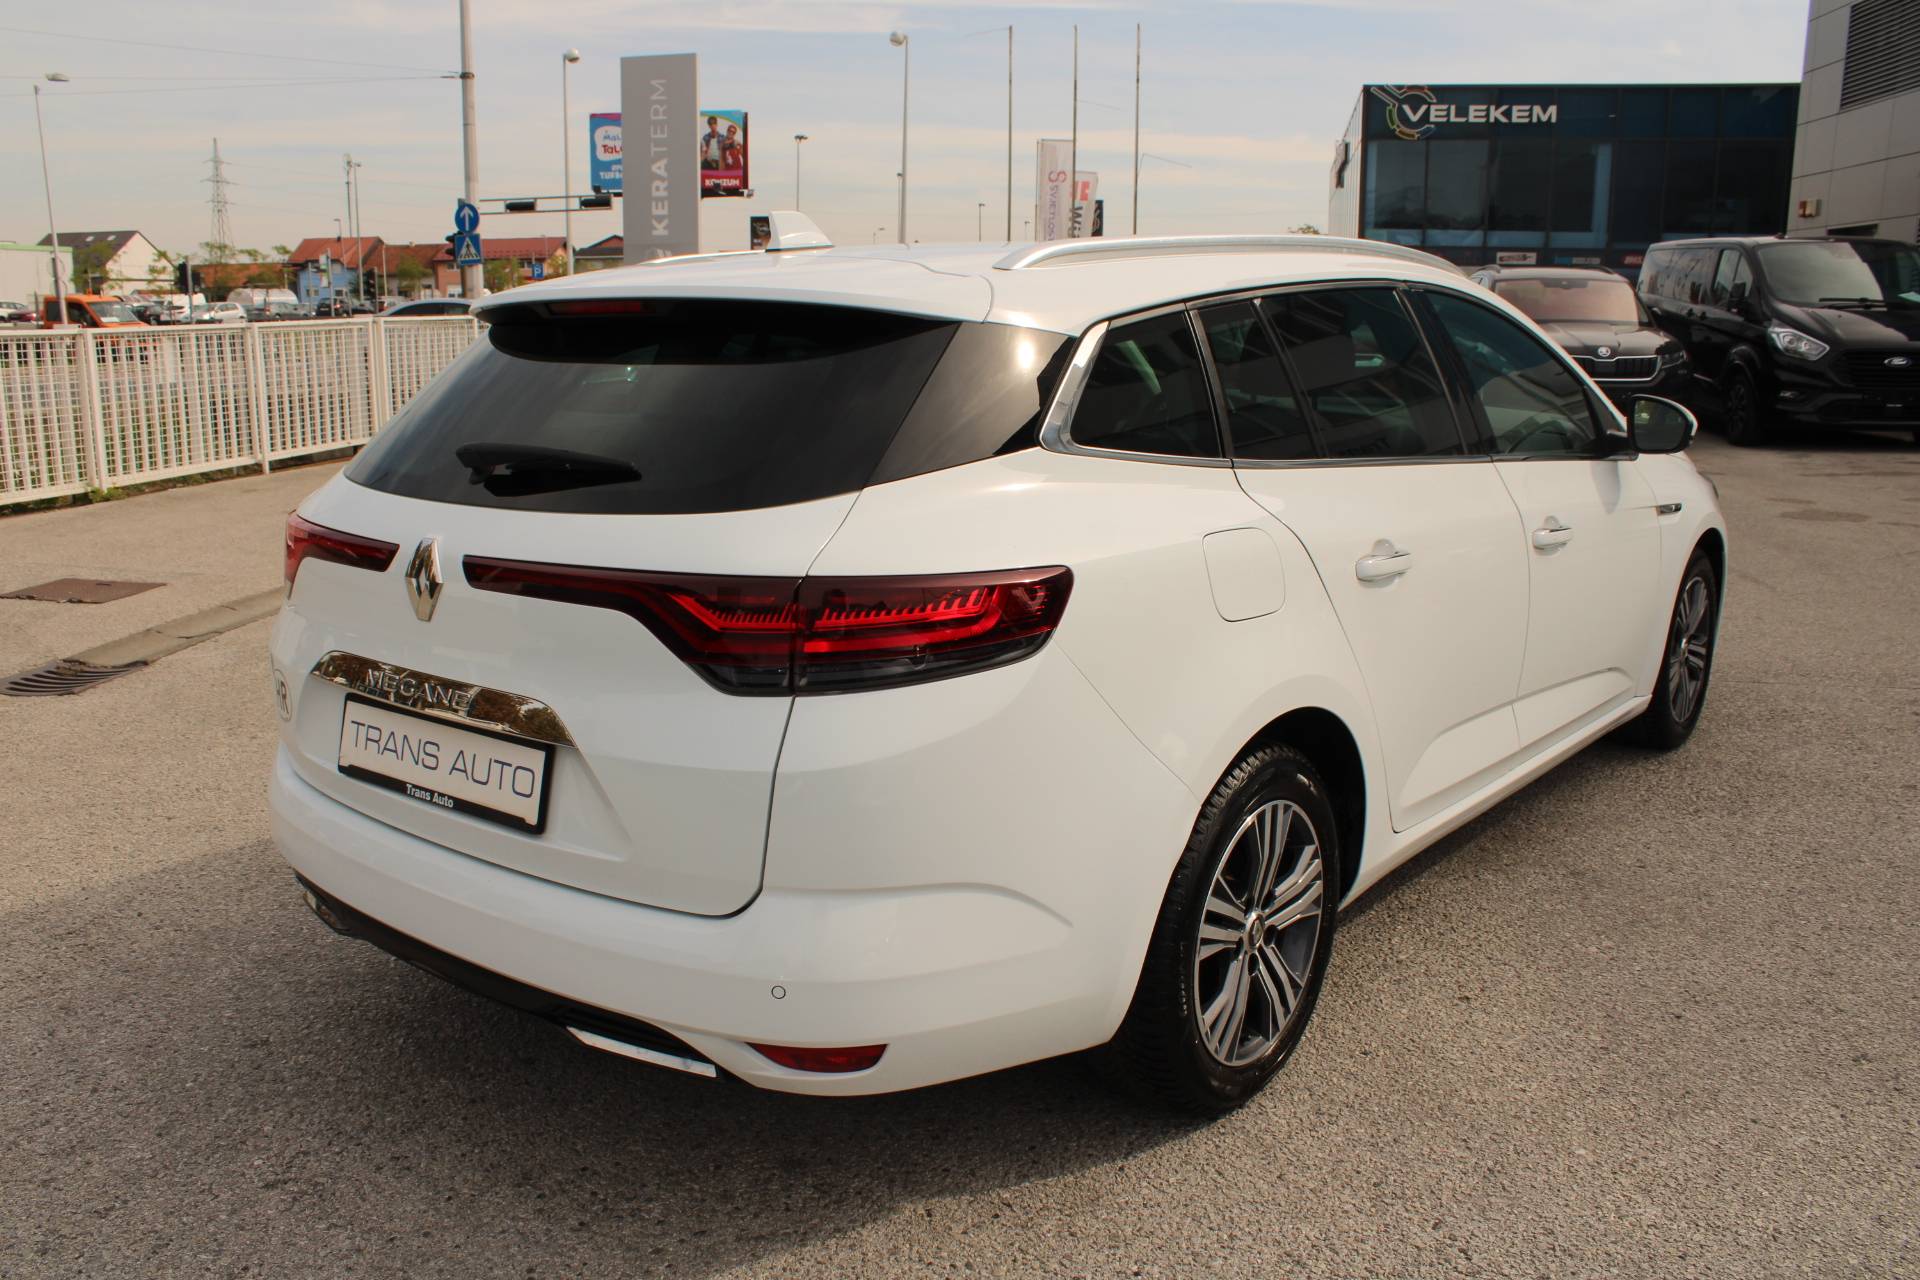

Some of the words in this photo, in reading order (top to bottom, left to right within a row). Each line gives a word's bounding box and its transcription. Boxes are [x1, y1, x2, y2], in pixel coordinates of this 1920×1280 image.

[1402, 104, 1558, 123] VELEKEM
[651, 79, 669, 236] KERATERM
[350, 720, 440, 771] TRANS
[449, 749, 536, 798] AUTO
[406, 783, 431, 801] Trans
[432, 792, 454, 808] Auto
